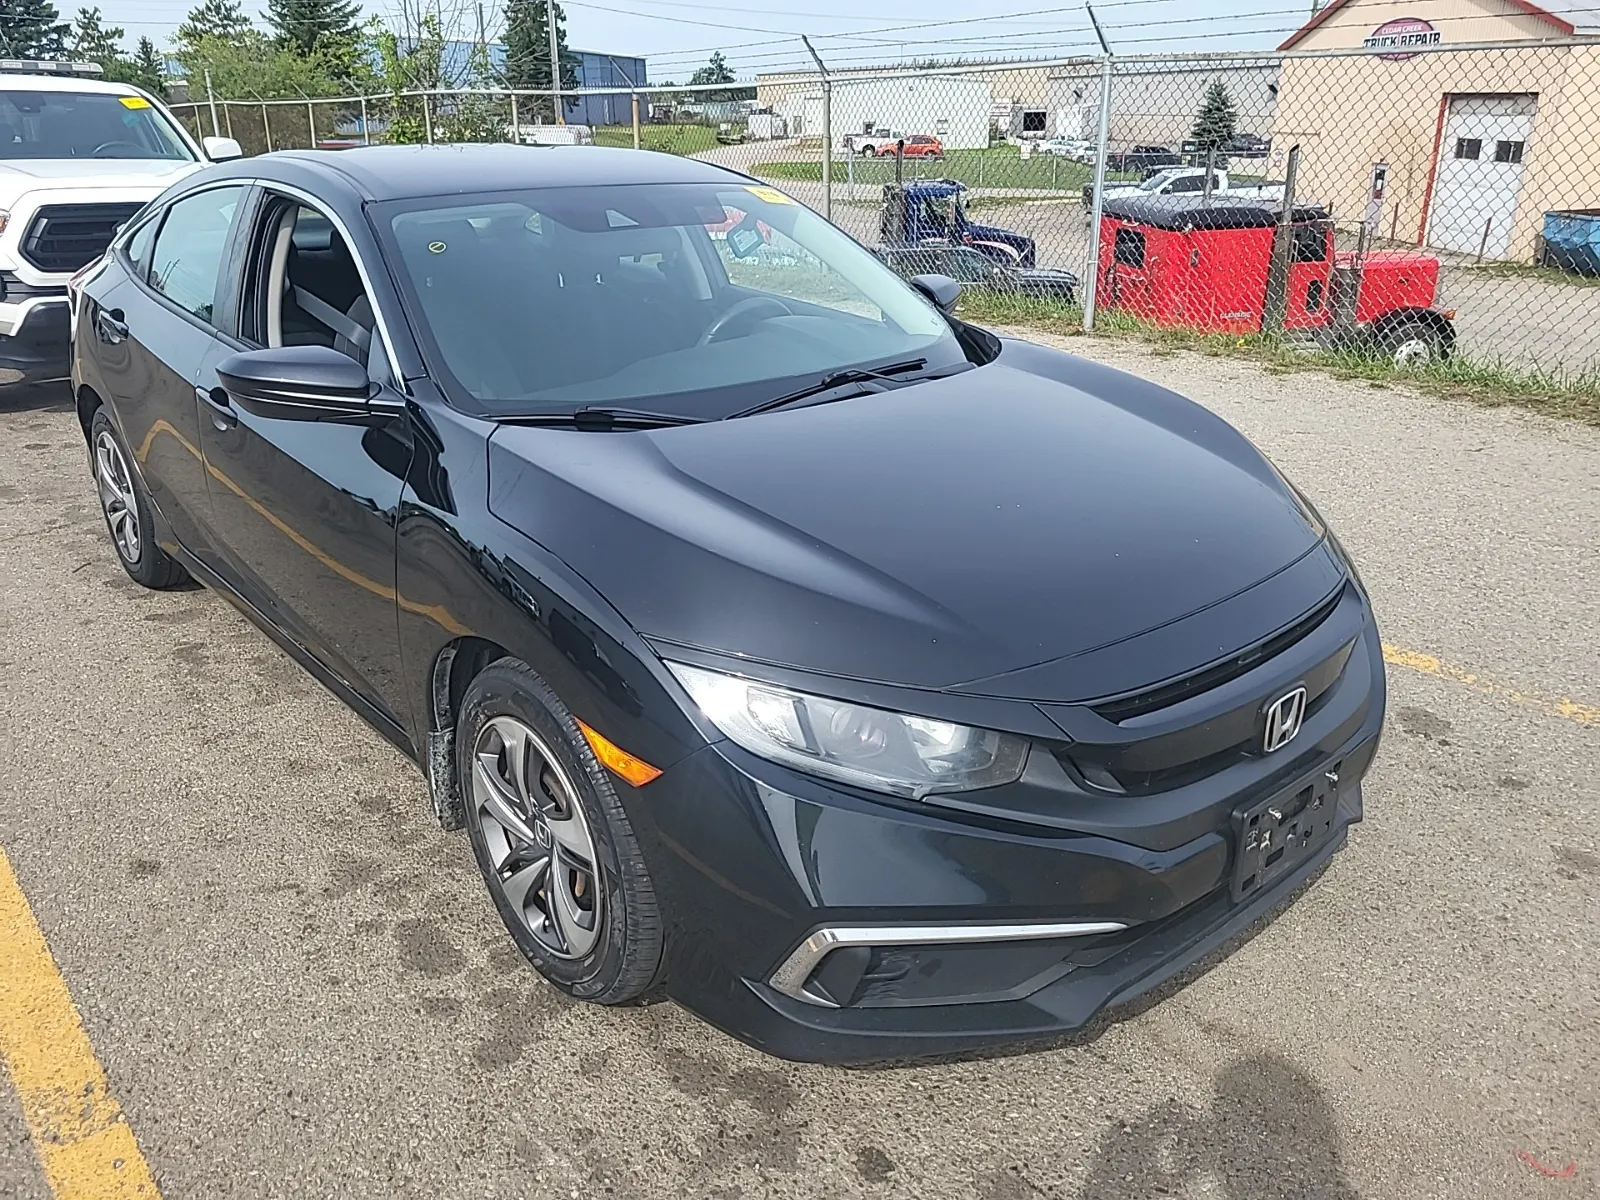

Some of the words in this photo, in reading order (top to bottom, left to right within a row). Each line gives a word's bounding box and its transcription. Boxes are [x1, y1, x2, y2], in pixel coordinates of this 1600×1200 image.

[1381, 26, 1402, 35] CEDAR
[1402, 24, 1423, 33] CREEK
[1363, 35, 1397, 48] TRUCK
[1399, 32, 1441, 47] REPAIR
